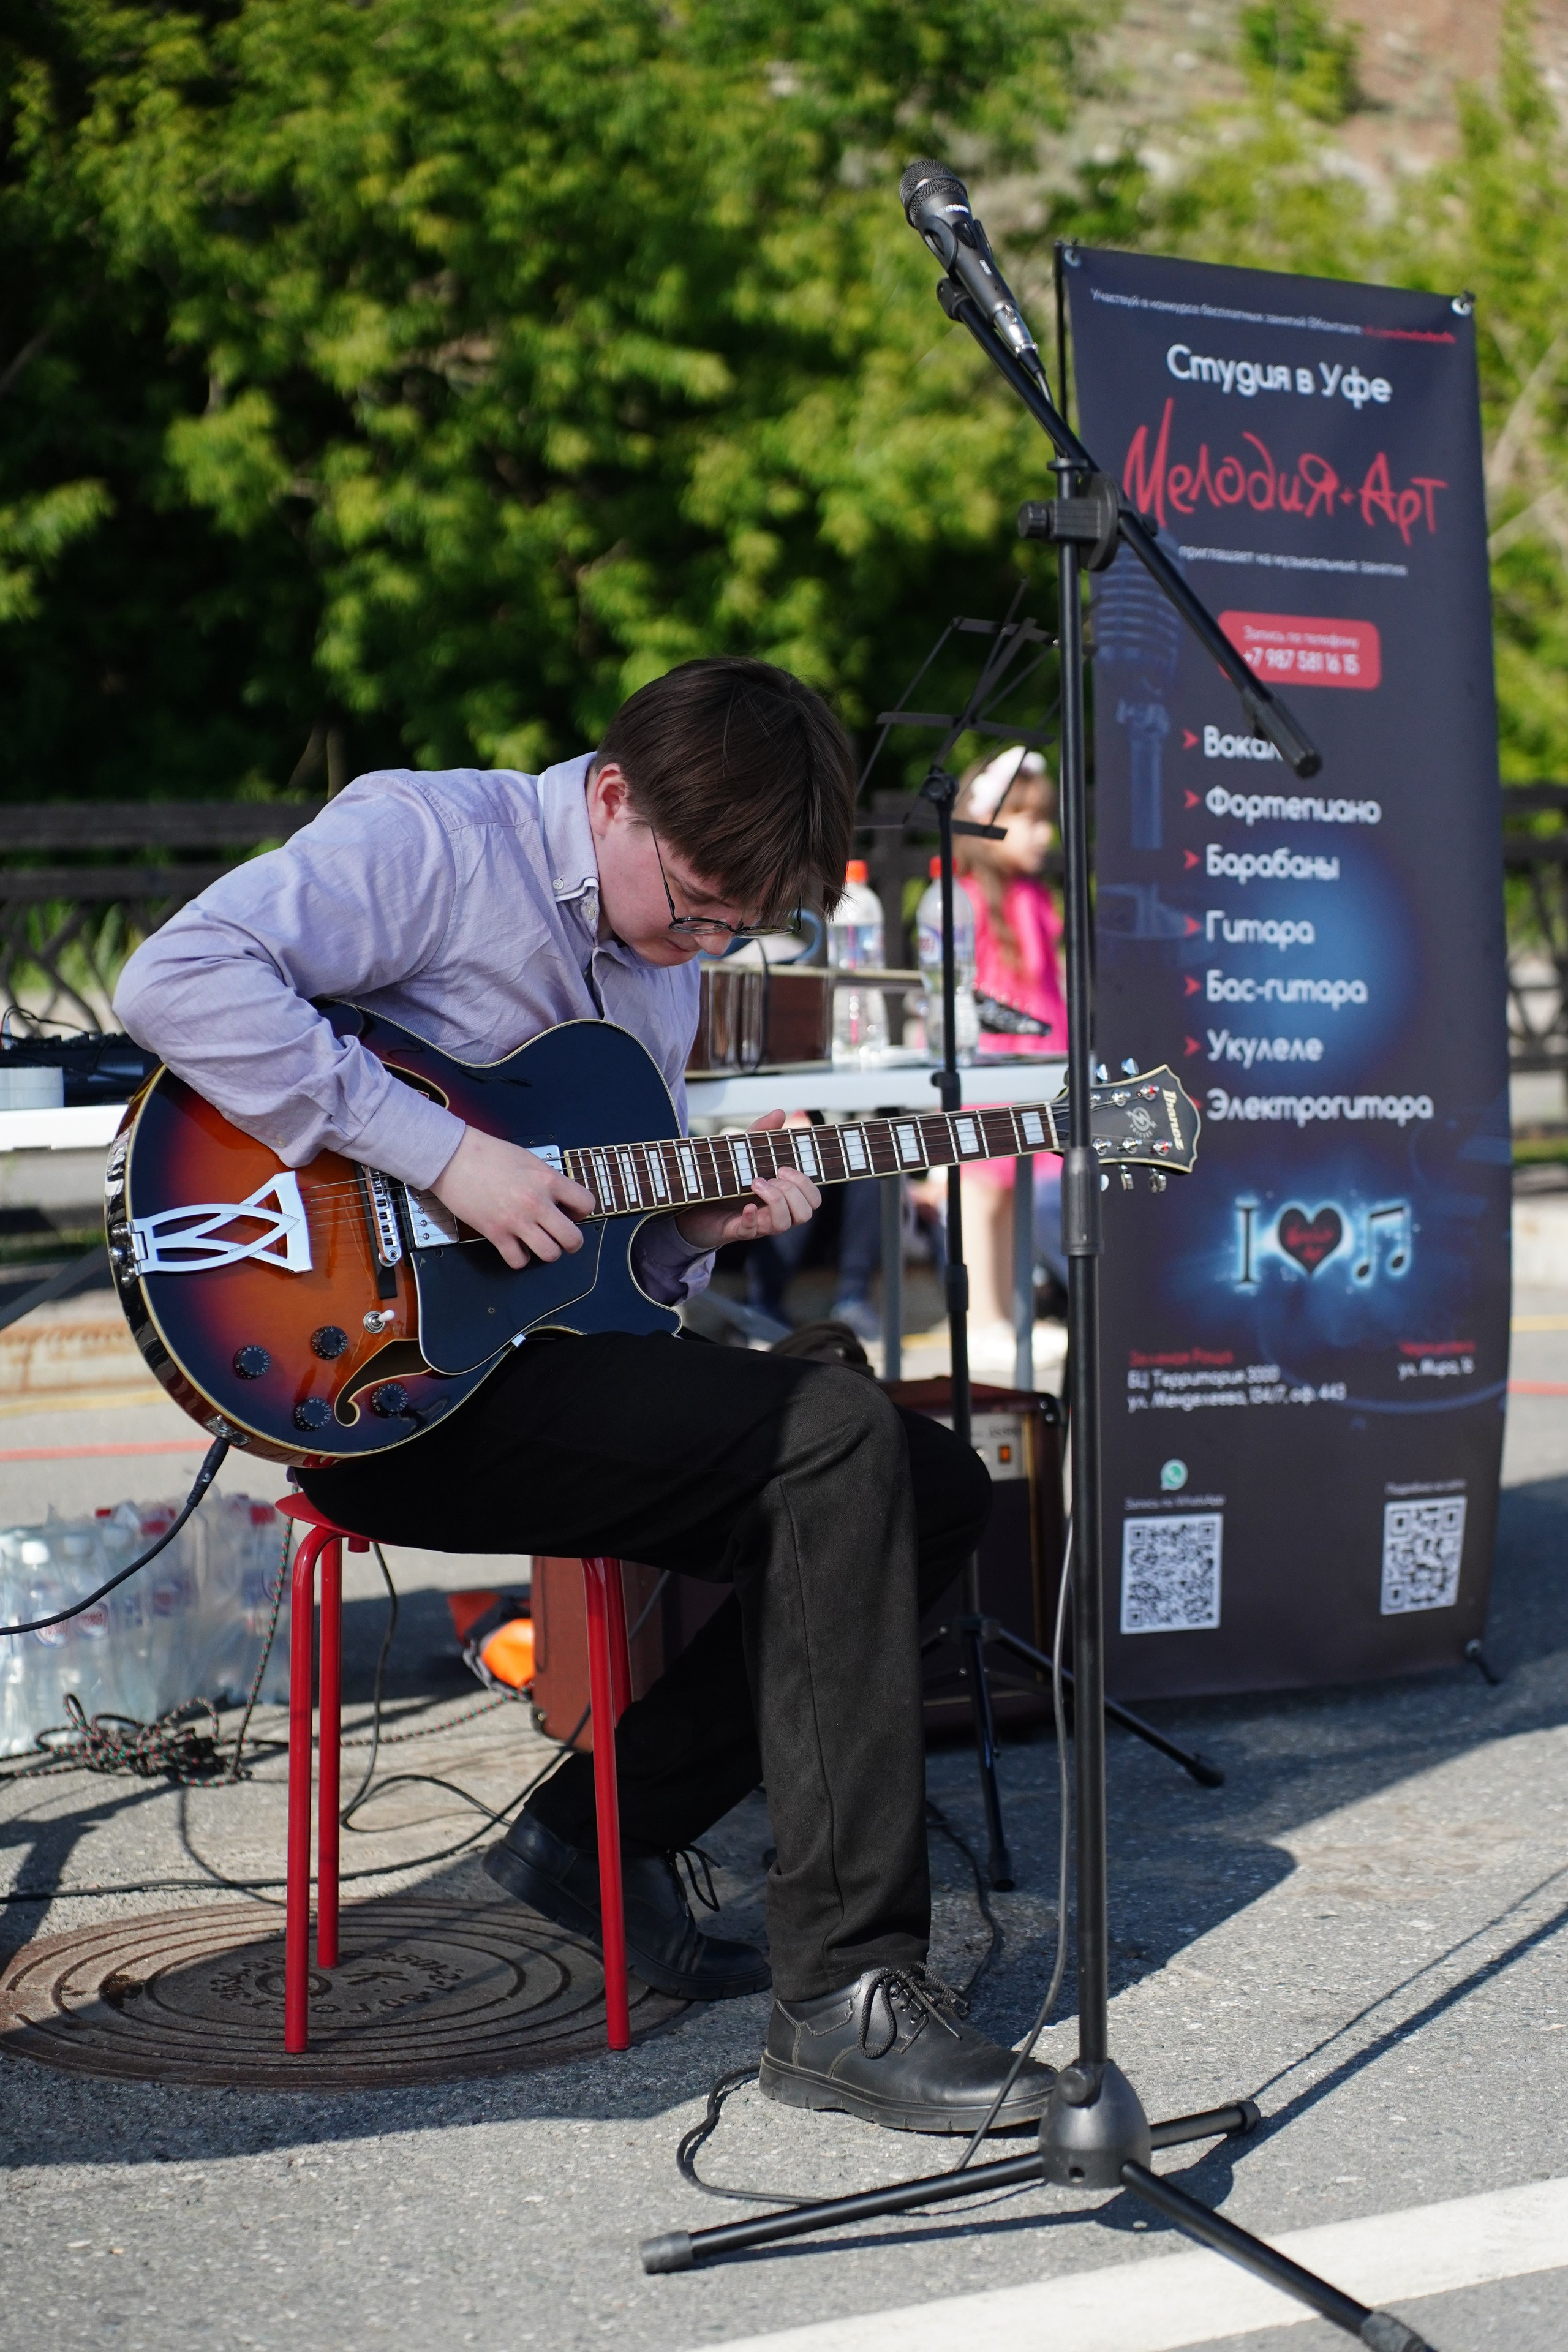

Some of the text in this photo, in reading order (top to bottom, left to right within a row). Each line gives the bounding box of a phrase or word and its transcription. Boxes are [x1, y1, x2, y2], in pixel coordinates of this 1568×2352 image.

[1166, 343, 1393, 409] Студия в Уфе
[1206, 785, 1382, 826] Фортепиано
[1206, 845, 1340, 885] Барабаны
[1206, 910, 1315, 952] Гитара
[1207, 970, 1368, 1011] Бас-гитара
[1207, 1029, 1324, 1069] Укулеле
[1162, 1088, 1185, 1150] Ibanez
[1207, 1088, 1434, 1128] Электрогитара
